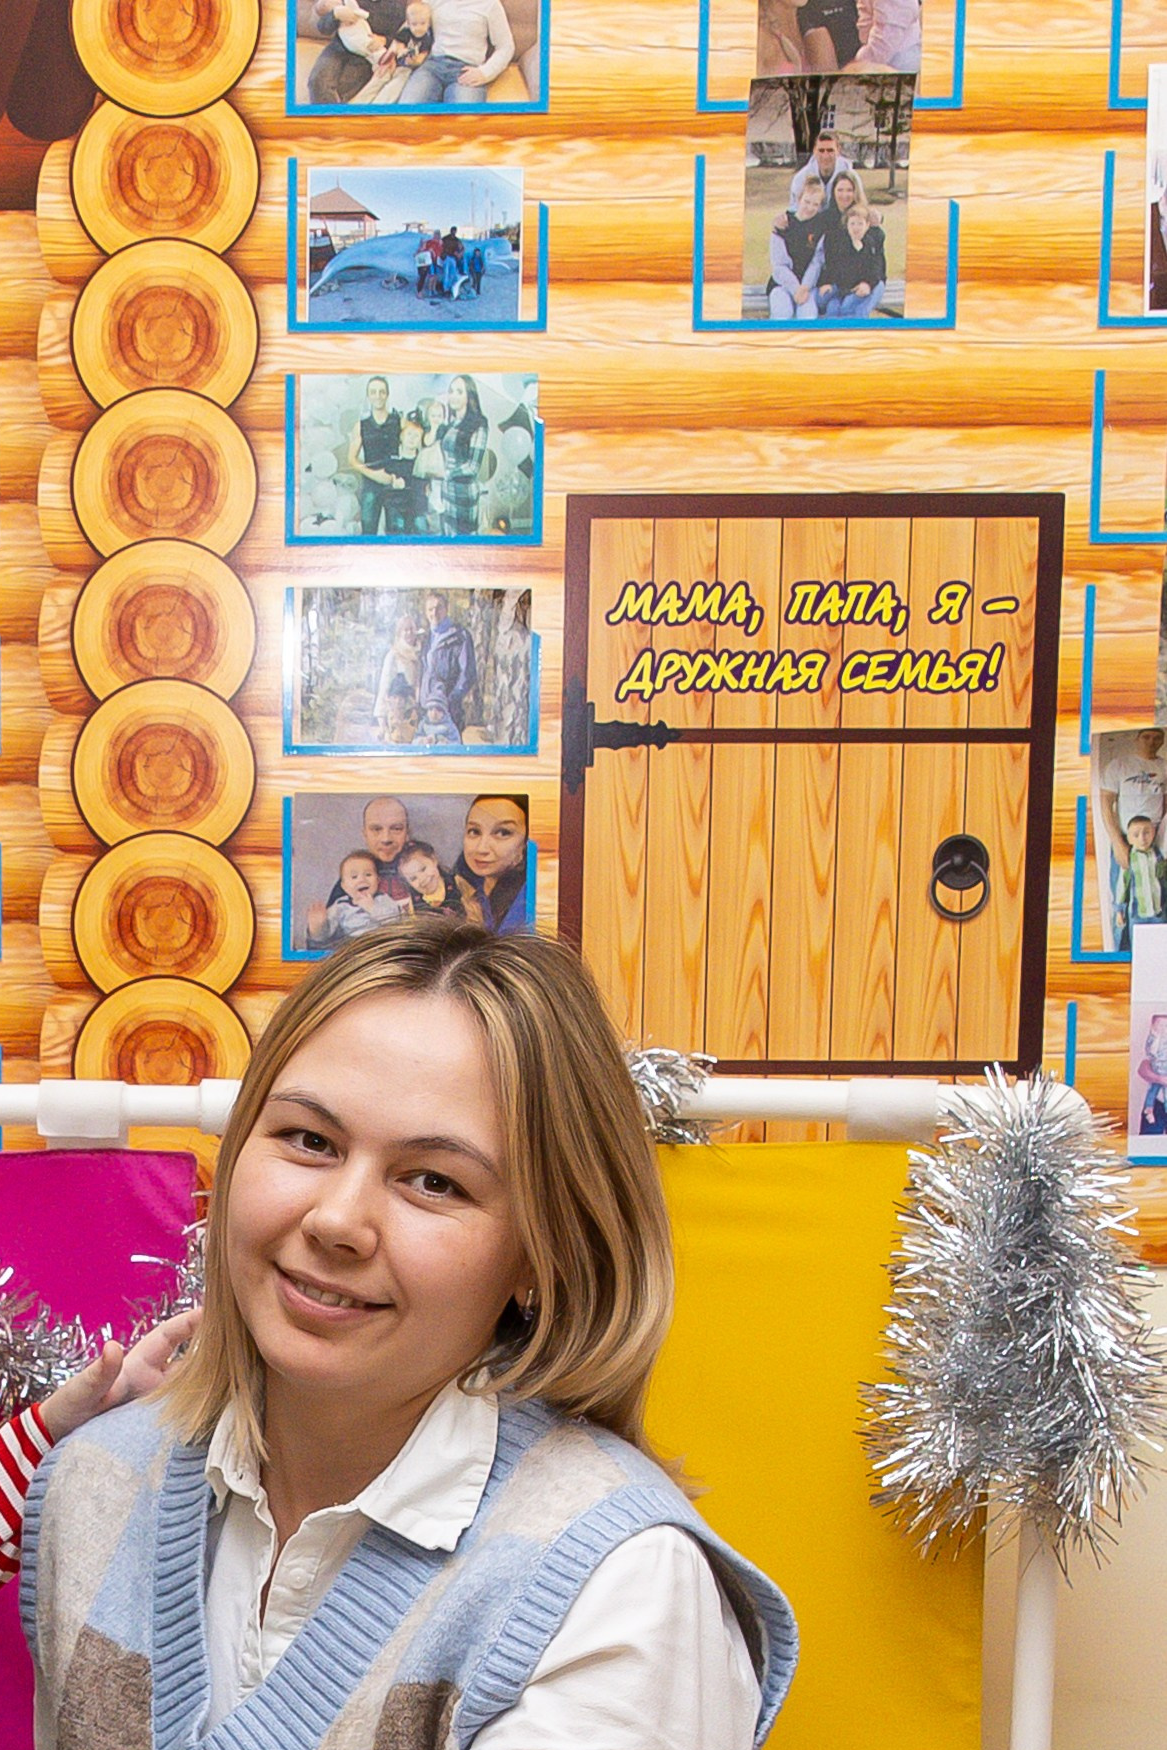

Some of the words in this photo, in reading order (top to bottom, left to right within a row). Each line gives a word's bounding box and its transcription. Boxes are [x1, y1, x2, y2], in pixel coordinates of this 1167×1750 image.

[608, 581, 764, 635] МАМА,
[785, 581, 909, 635] ПАПА,
[928, 581, 970, 625] Я
[616, 648, 831, 702] ДРУЖНАЯ
[837, 642, 1006, 694] СЕМЬЯ!
